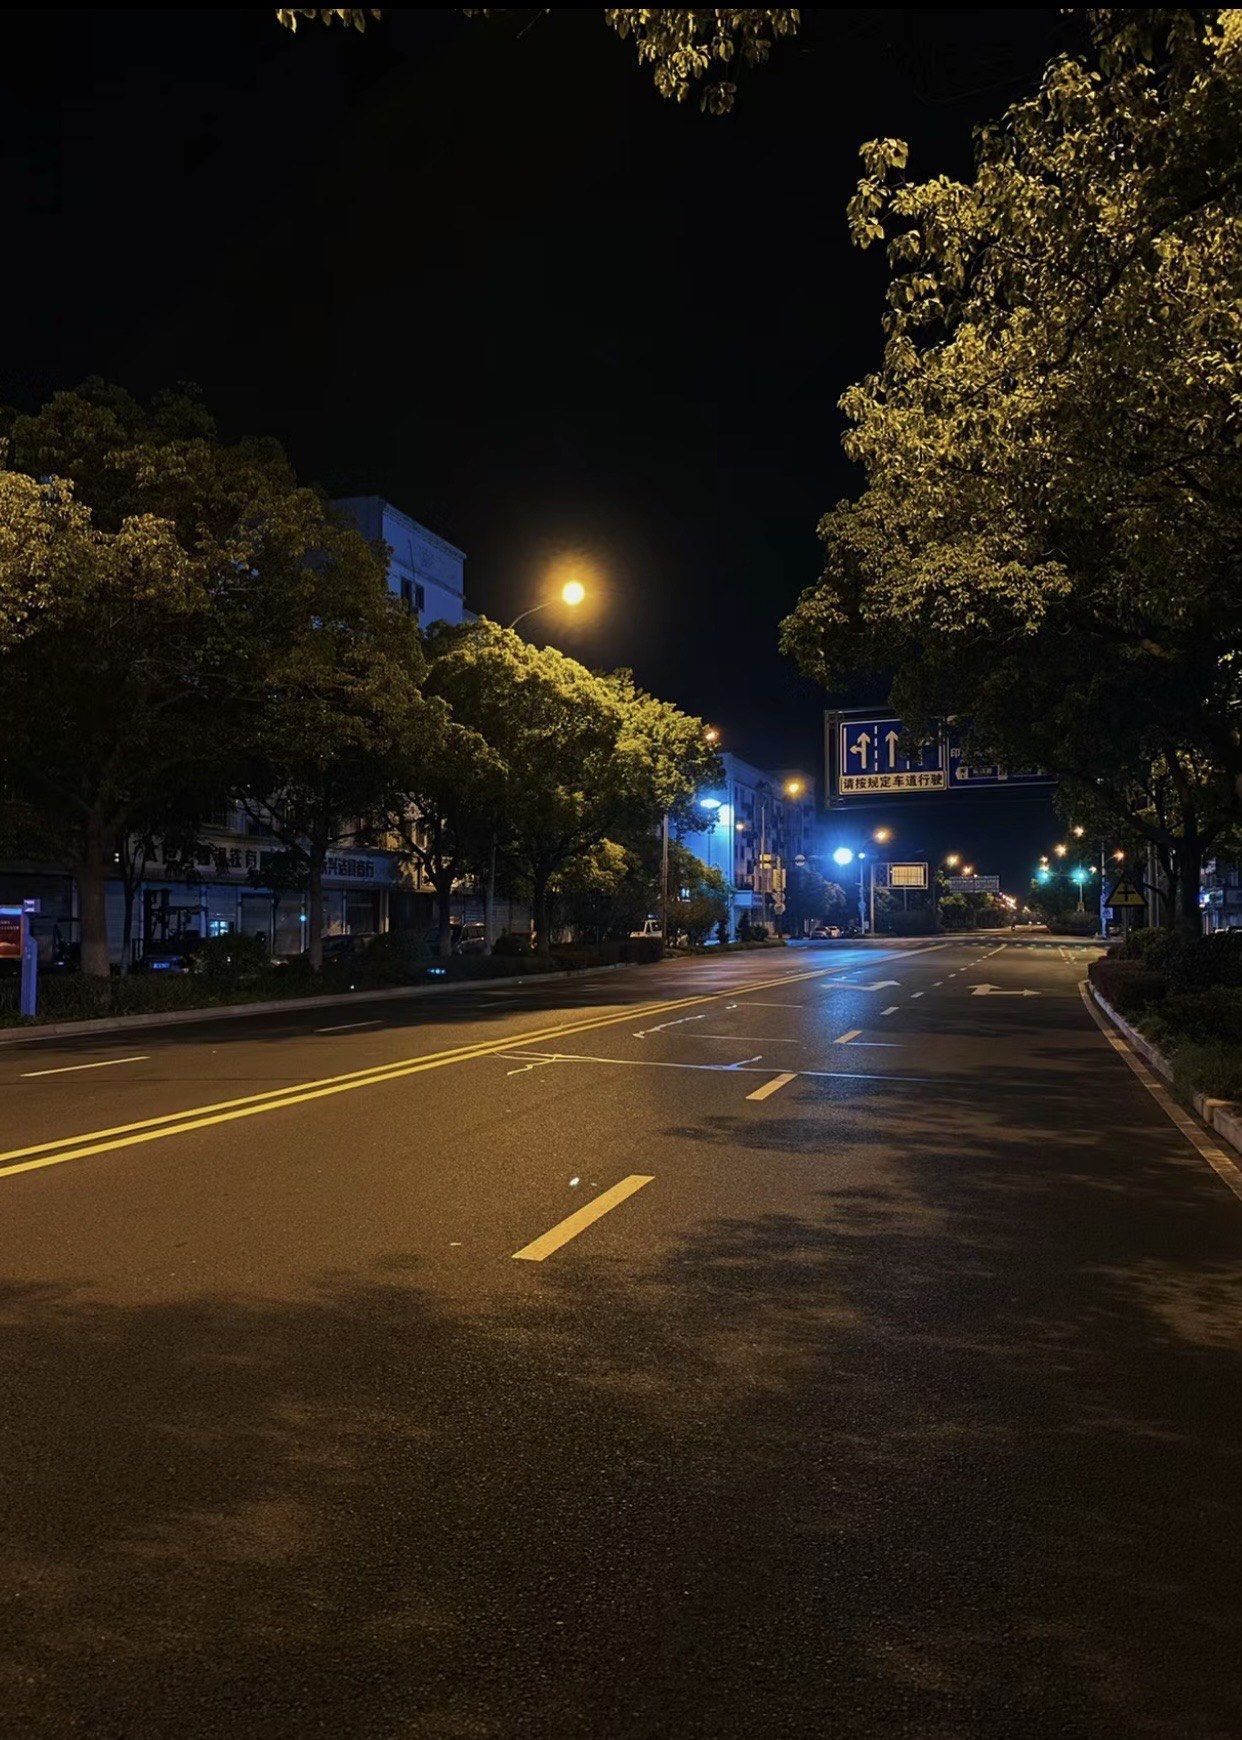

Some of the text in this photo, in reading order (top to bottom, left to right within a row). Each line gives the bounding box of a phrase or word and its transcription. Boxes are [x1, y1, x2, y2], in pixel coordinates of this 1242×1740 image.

[844, 773, 942, 789] 请按规定车道行驶
